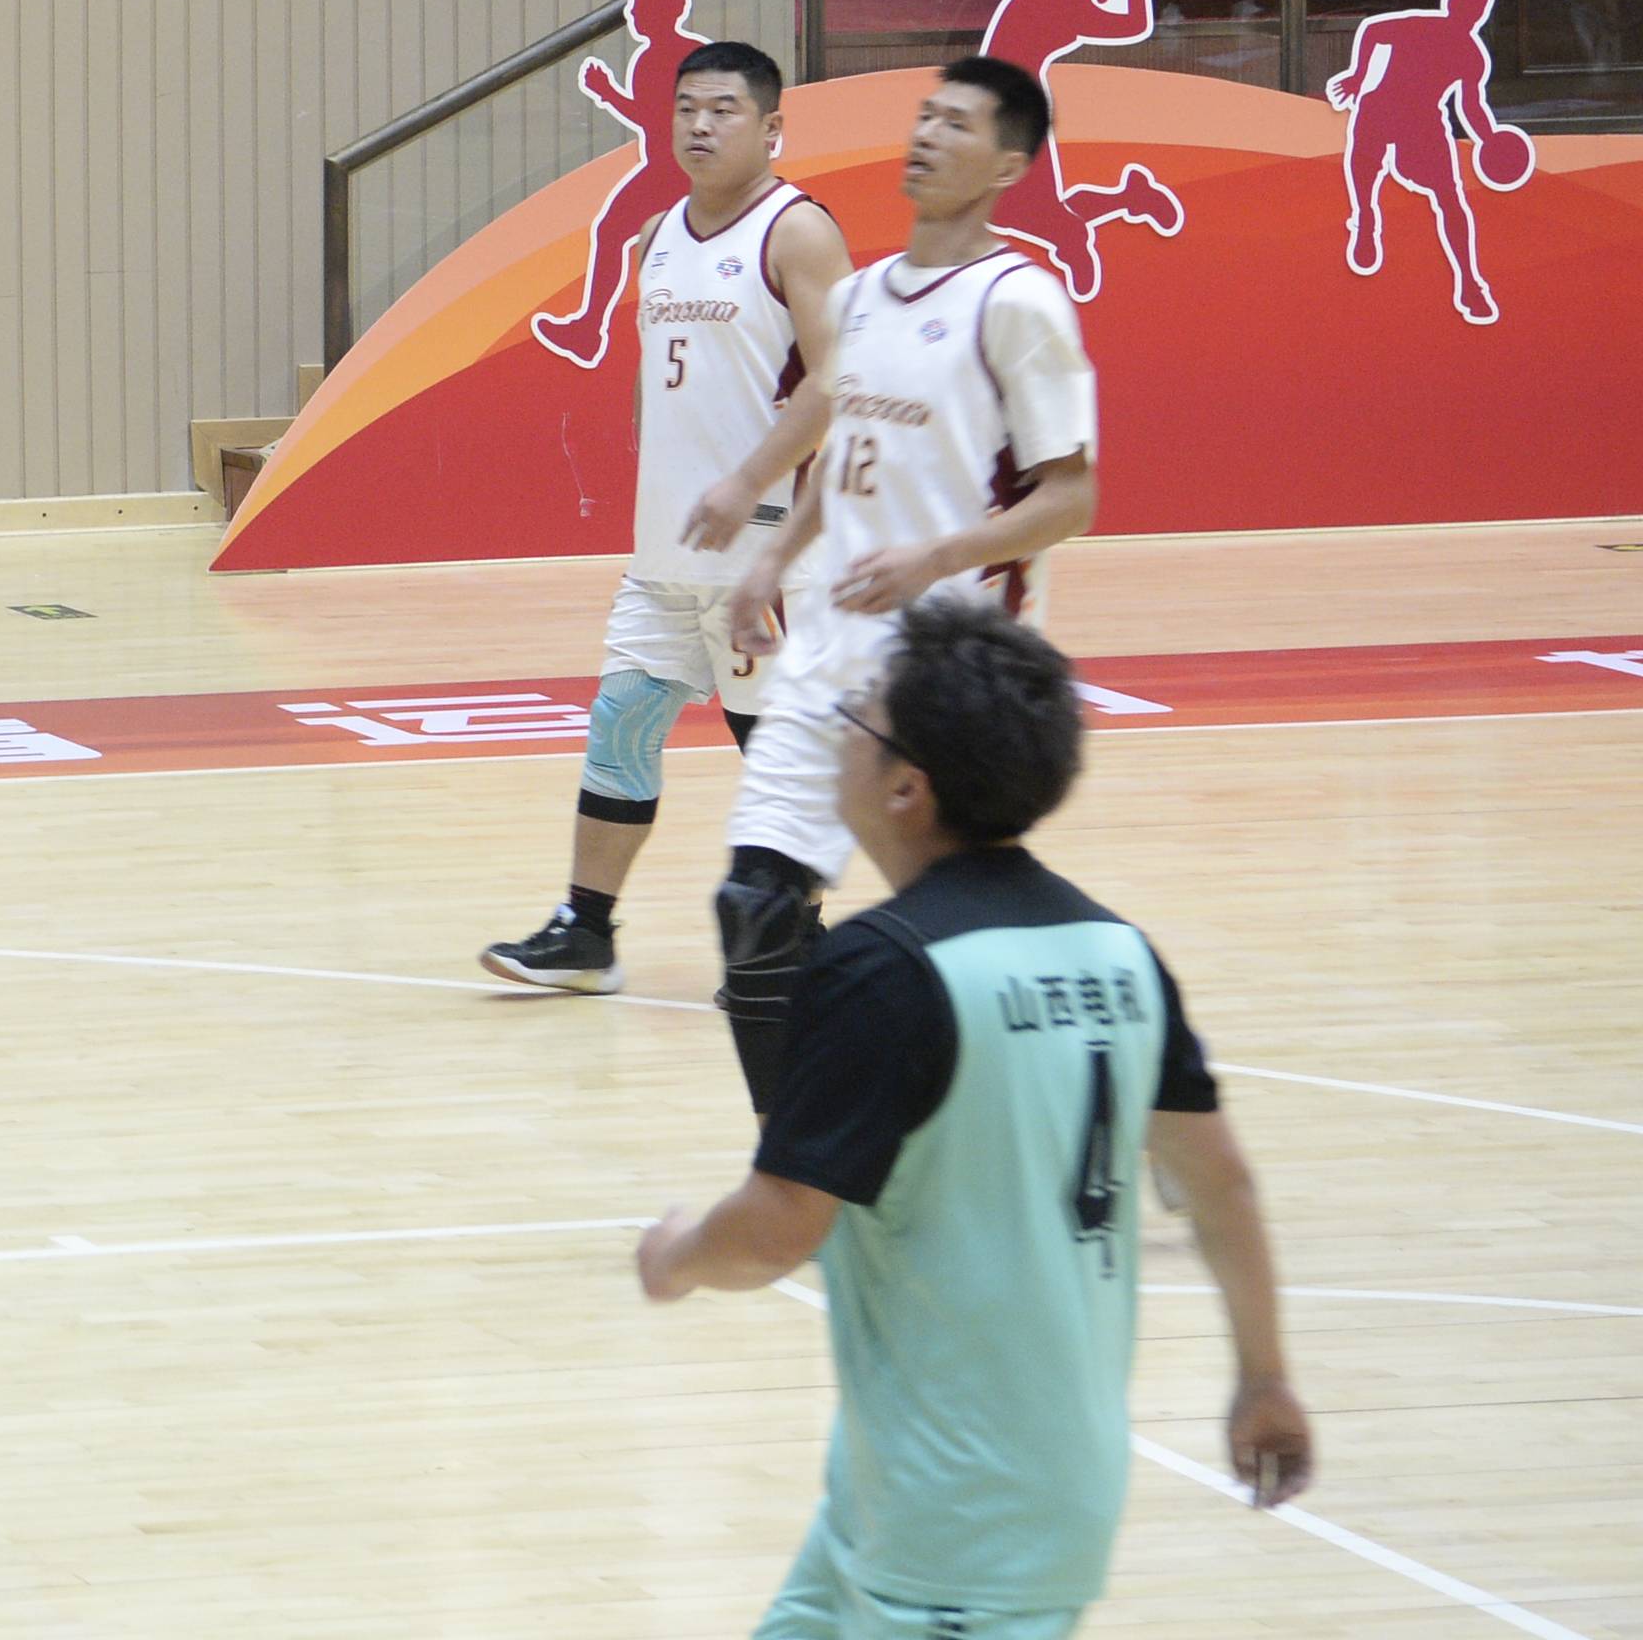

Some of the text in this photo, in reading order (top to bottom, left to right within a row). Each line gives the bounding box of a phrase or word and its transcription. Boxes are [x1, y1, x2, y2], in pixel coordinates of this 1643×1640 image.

[665, 338, 687, 391] 5
[839, 433, 878, 496] 12
[995, 966, 1151, 1036] 山西电机
